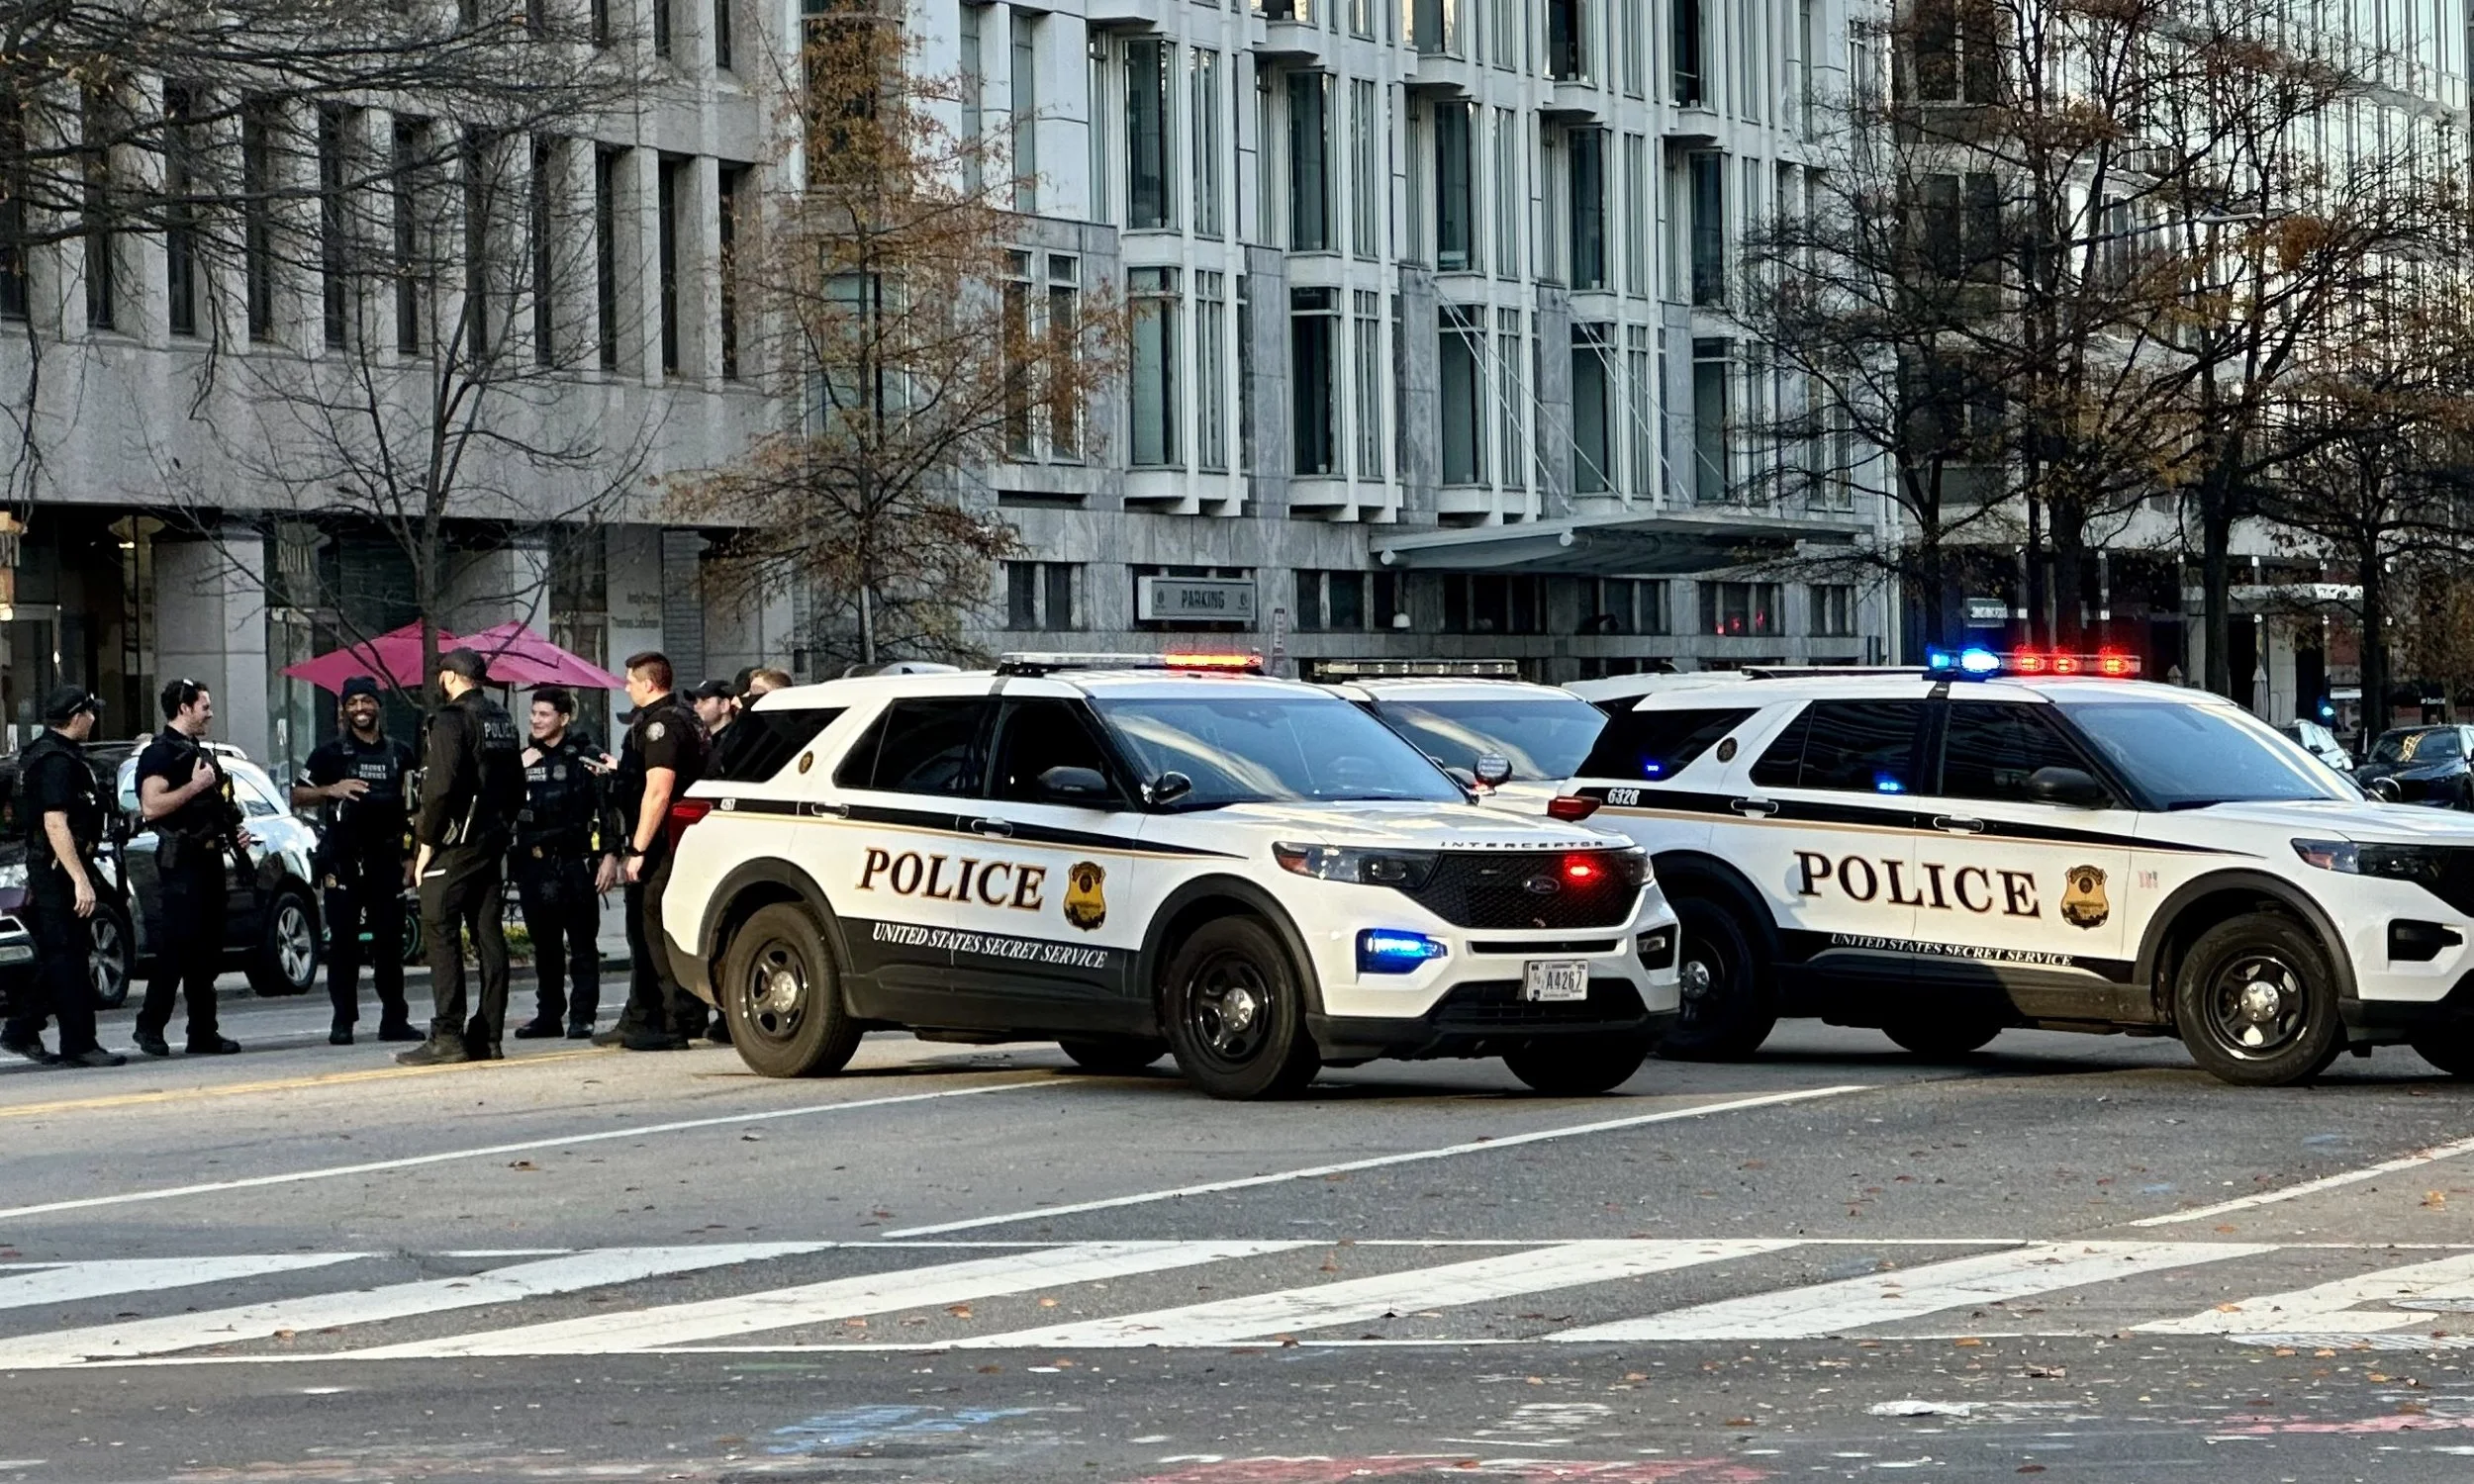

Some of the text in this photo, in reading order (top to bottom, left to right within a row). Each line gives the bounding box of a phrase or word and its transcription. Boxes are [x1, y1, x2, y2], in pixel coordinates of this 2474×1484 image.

[1182, 590, 1224, 609] PARKING
[1607, 788, 1640, 805] 6328
[1440, 840, 1604, 849] INTERCEPTOR
[855, 847, 1047, 911] POLICE
[1793, 849, 2042, 919] POLICE
[872, 922, 1108, 969] UNITED STATES SECRET SERVICE
[1831, 933, 2073, 967] UNITED STATES SECRET SERVICE
[1546, 971, 1582, 990] A4267
